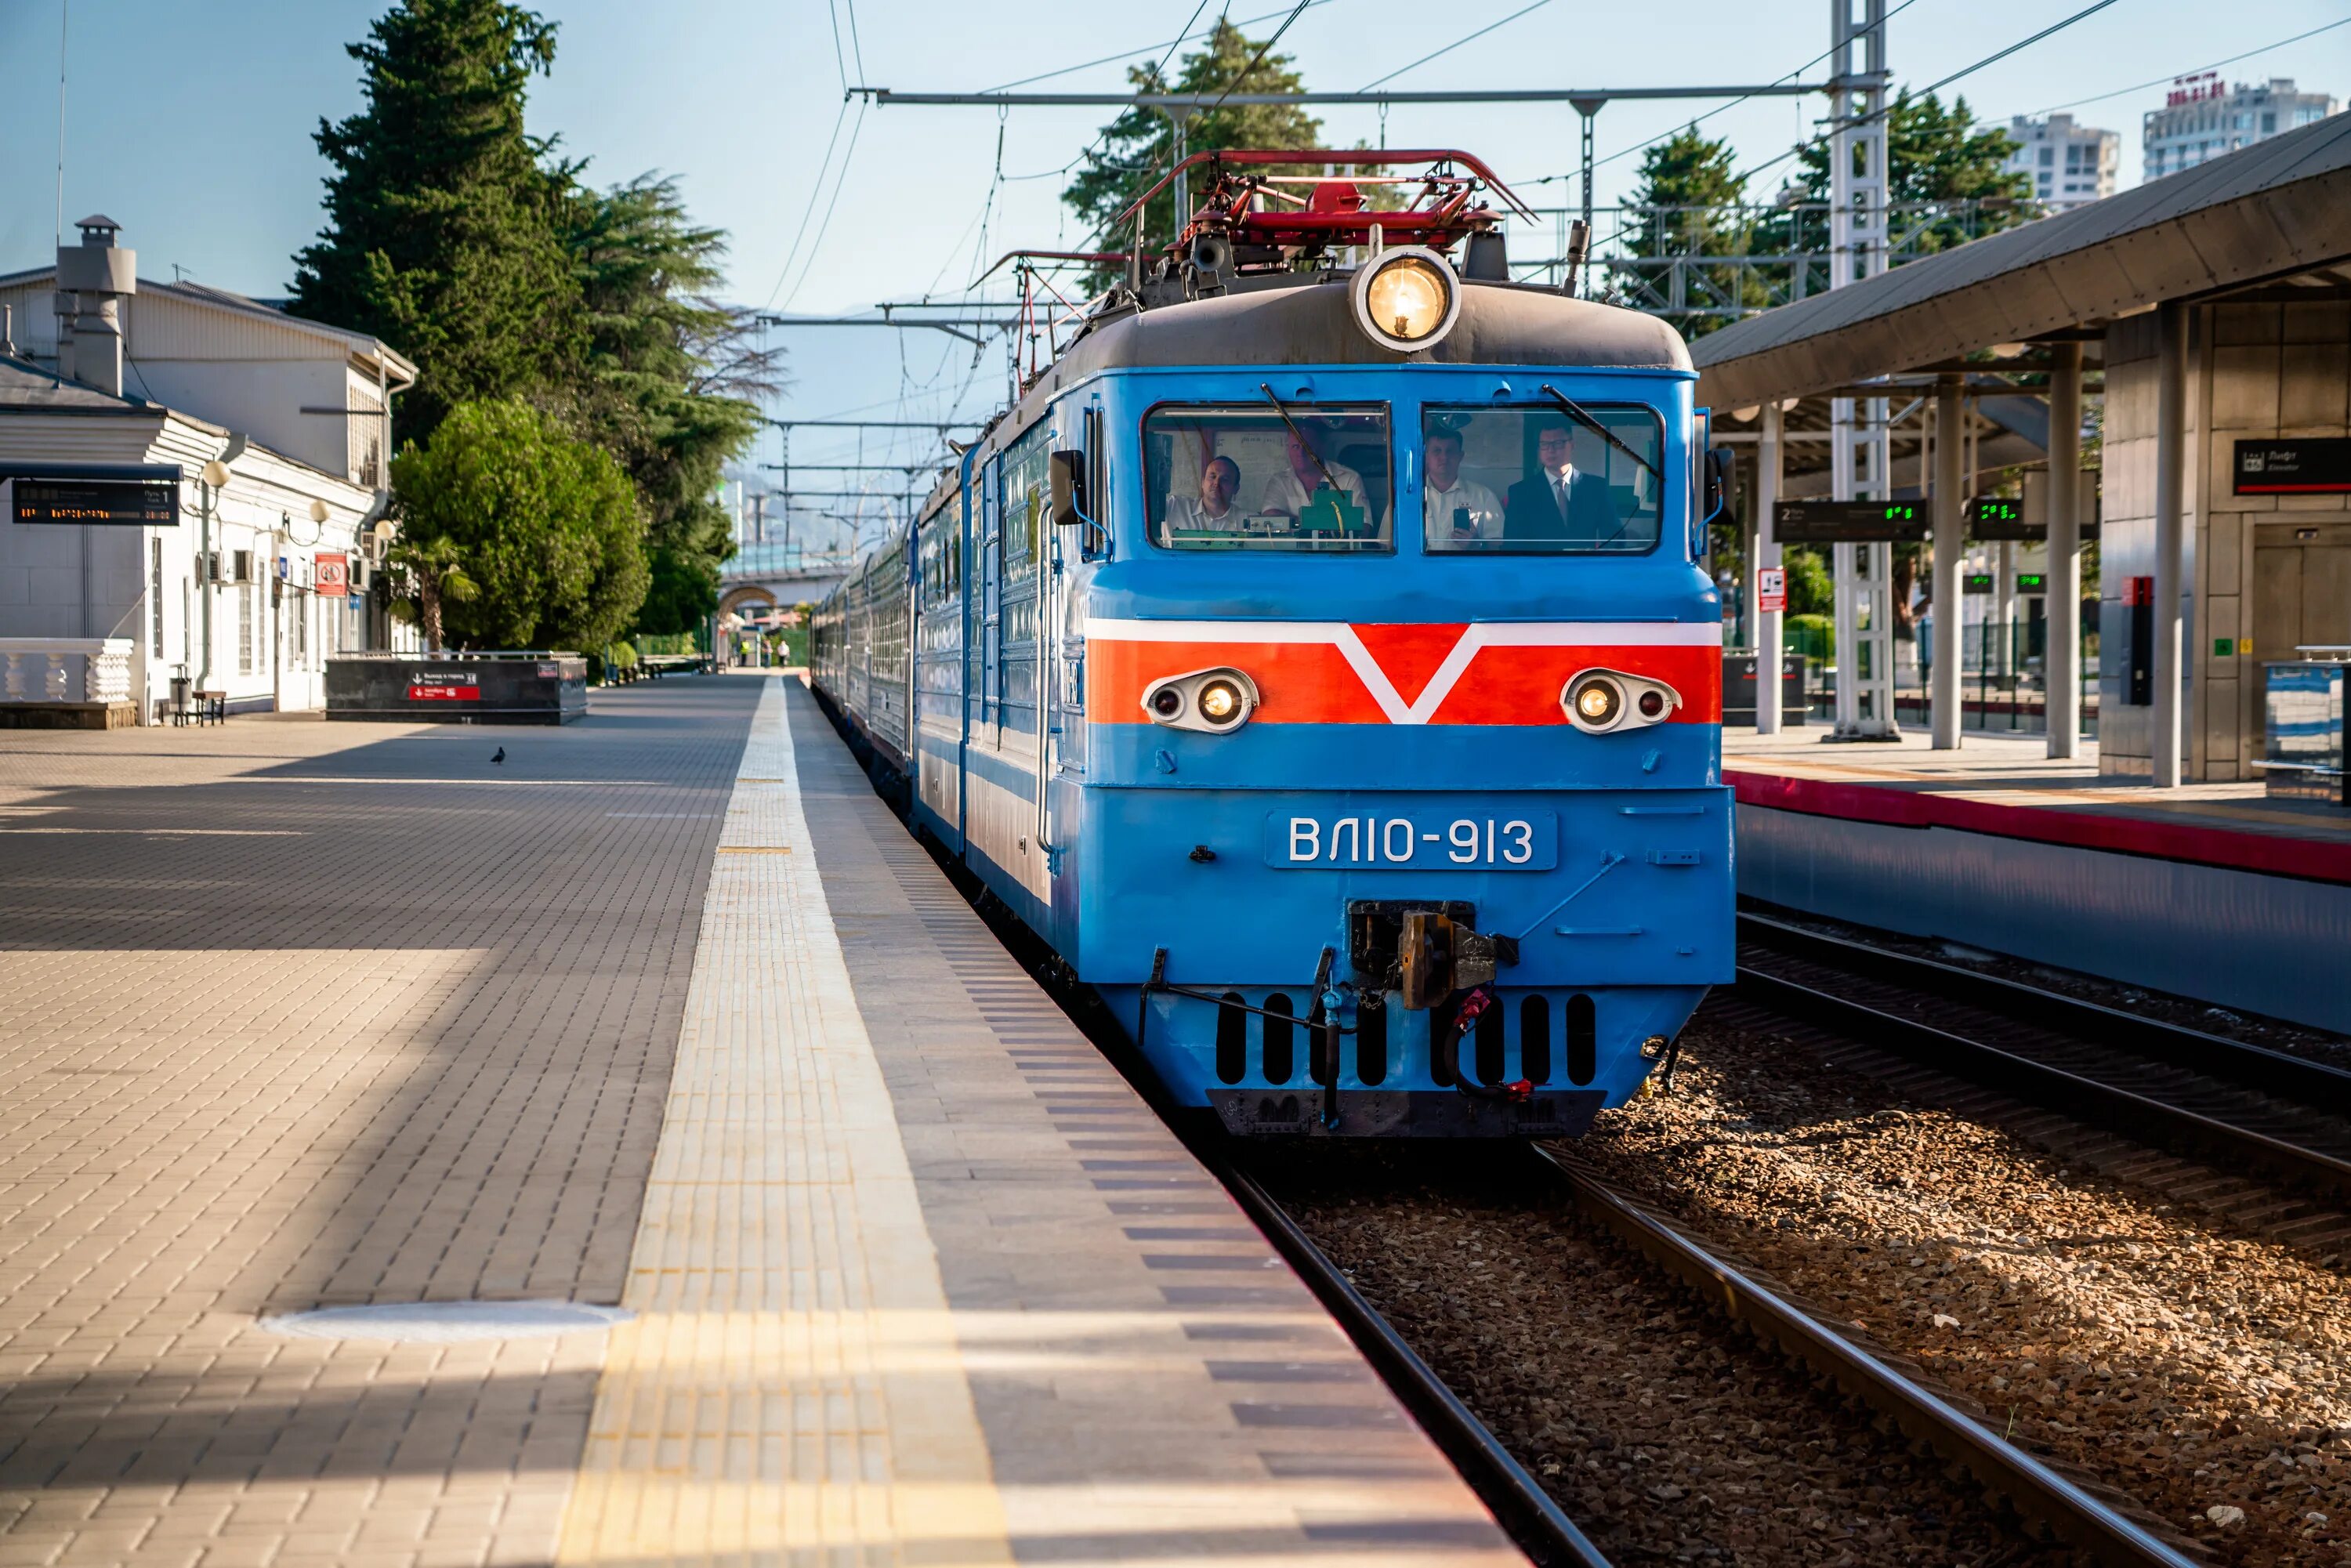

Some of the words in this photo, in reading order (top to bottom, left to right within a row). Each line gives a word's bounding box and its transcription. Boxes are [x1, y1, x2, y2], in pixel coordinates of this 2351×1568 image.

[162, 491, 168, 503] 1
[1781, 508, 1791, 521] 2
[1289, 817, 1533, 864] ВЛ10-913
